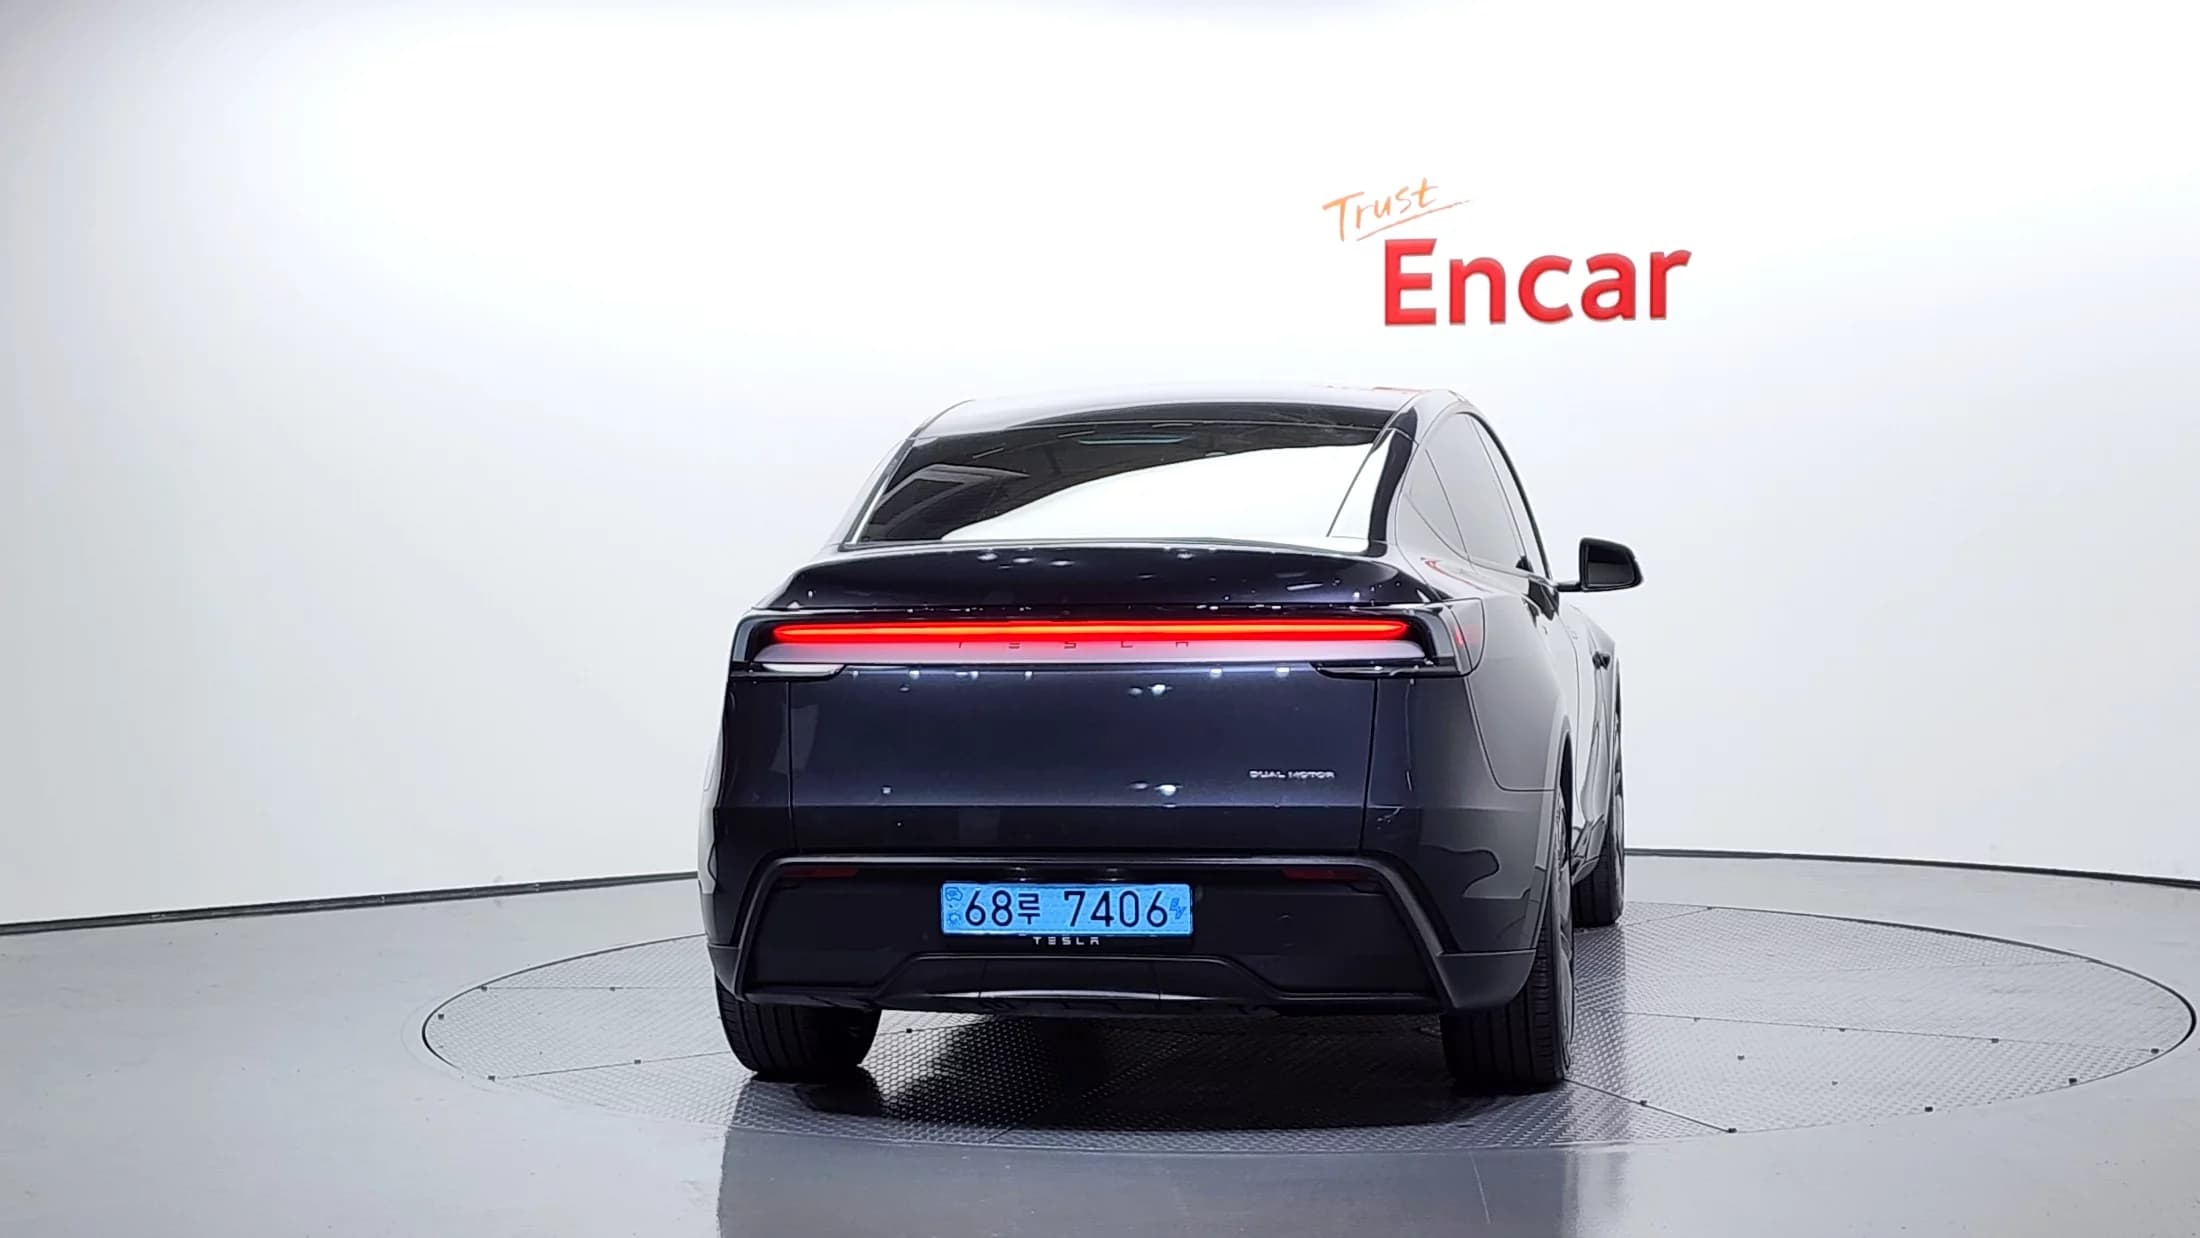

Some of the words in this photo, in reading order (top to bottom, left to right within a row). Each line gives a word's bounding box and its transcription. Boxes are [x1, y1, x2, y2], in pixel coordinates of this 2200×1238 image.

[1321, 177, 1439, 242] Trust
[1384, 238, 1692, 327] Encar
[1248, 770, 1286, 779] DUAL
[1287, 770, 1335, 779] MOTOR
[964, 889, 1041, 927] 68루
[1063, 889, 1169, 928] 7406
[1032, 936, 1100, 946] TESLA
